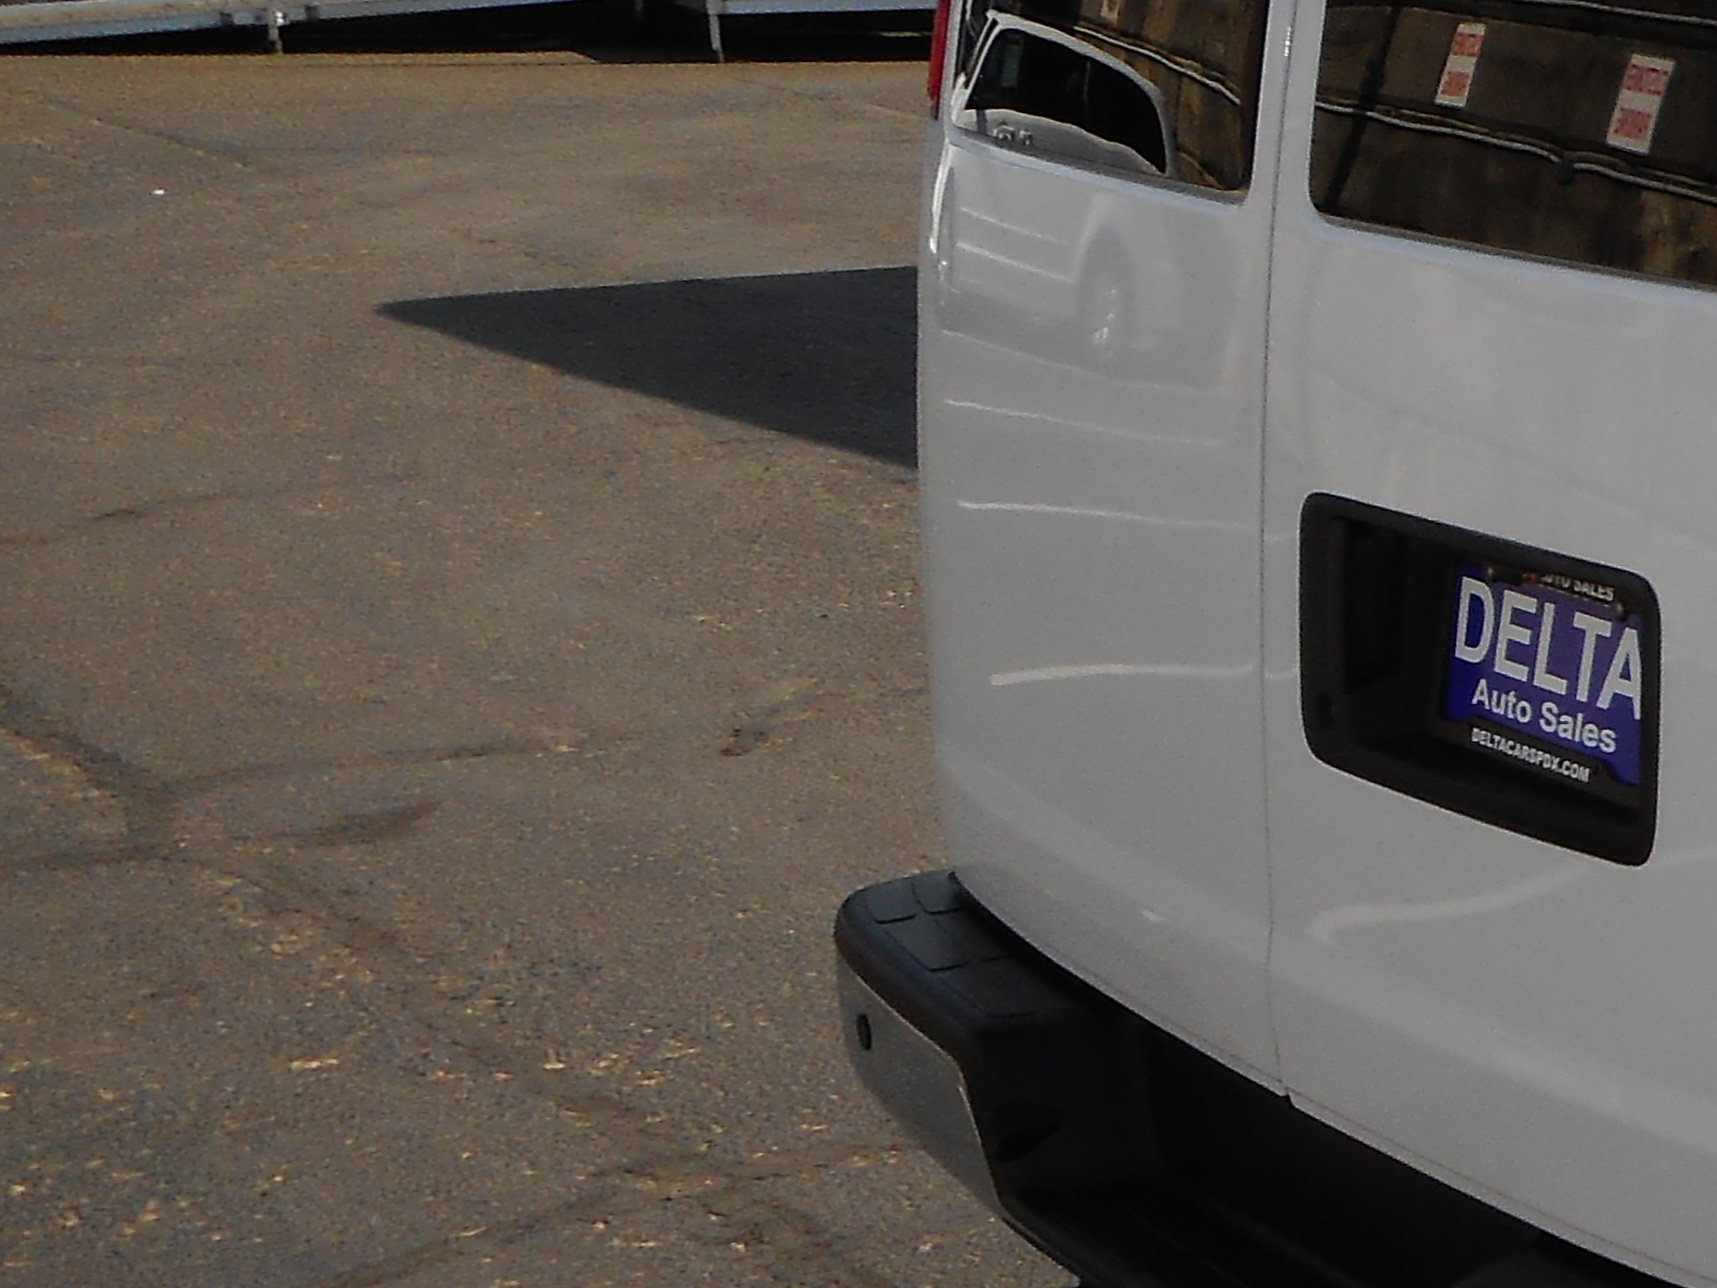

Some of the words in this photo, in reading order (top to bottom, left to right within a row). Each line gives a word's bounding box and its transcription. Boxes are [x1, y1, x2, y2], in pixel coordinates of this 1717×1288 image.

[1454, 576, 1642, 720] DELTA
[1471, 678, 1532, 724] Auto
[1539, 702, 1618, 754] Sales
